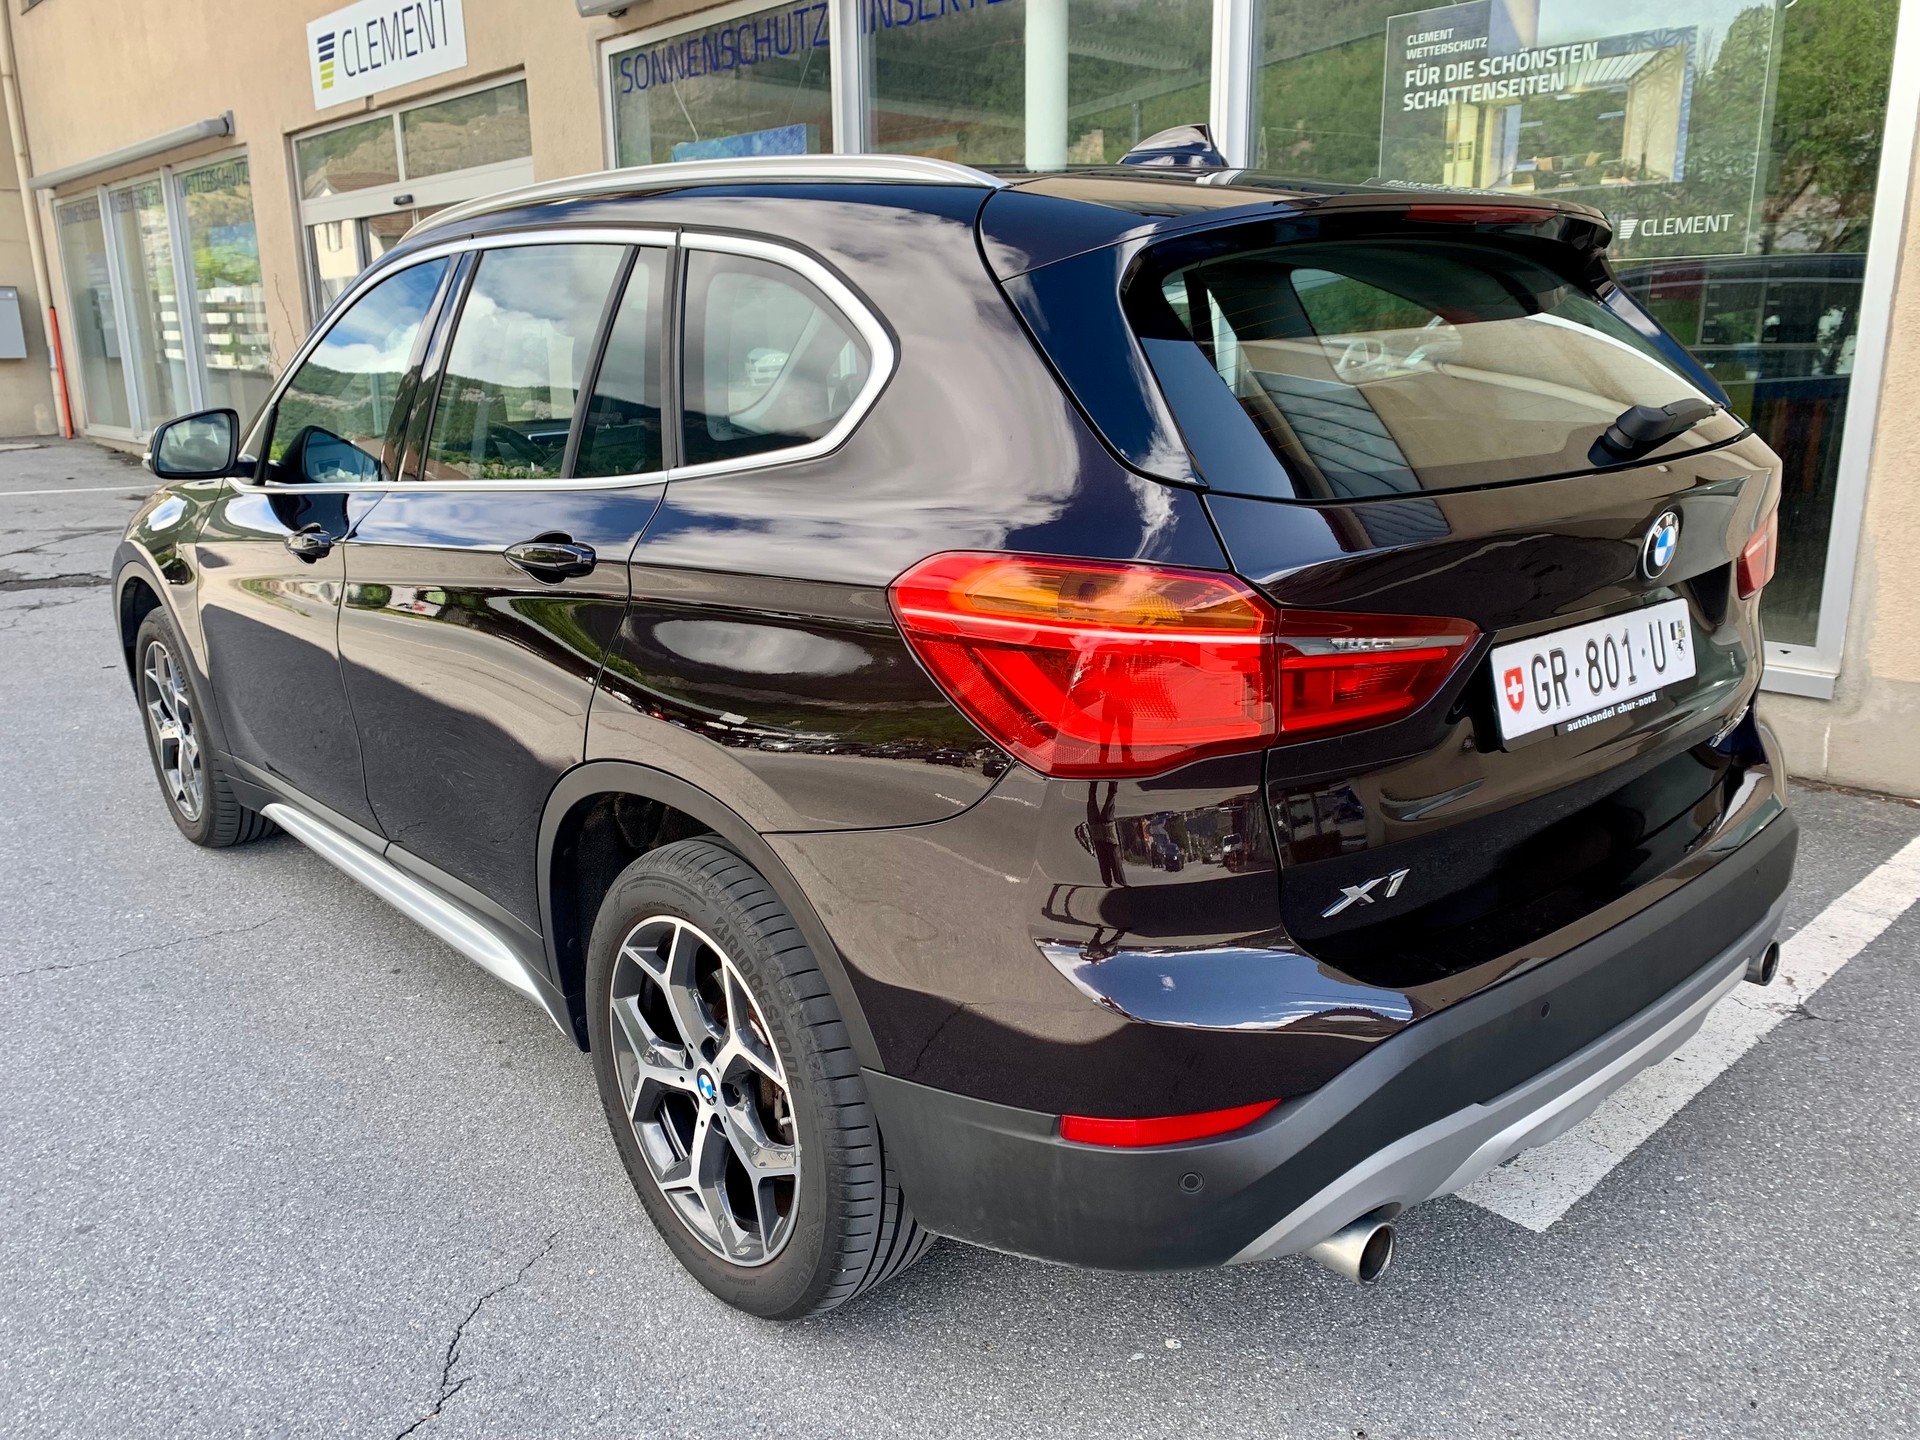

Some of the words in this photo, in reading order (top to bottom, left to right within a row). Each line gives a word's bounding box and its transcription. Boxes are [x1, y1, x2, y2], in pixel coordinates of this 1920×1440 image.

[342, 0, 448, 77] CLEMENT
[620, 2, 829, 94] SONNENSCHUTZ
[1406, 37, 1488, 59] WETTERSCHUTZ
[1407, 28, 1454, 46] CLEMENT
[1405, 64, 1441, 88] FÜR
[1445, 61, 1475, 83] DIE
[1478, 42, 1599, 78] SCHÖNSTEN
[1403, 72, 1565, 112] SCHATTENSEITEN
[1641, 213, 1735, 237] CLEMENT
[1567, 706, 1615, 732] autohandel
[1617, 692, 1657, 714] chur-nord
[1320, 867, 1410, 918] X1
[712, 916, 805, 1091] BRIDGESTONE
